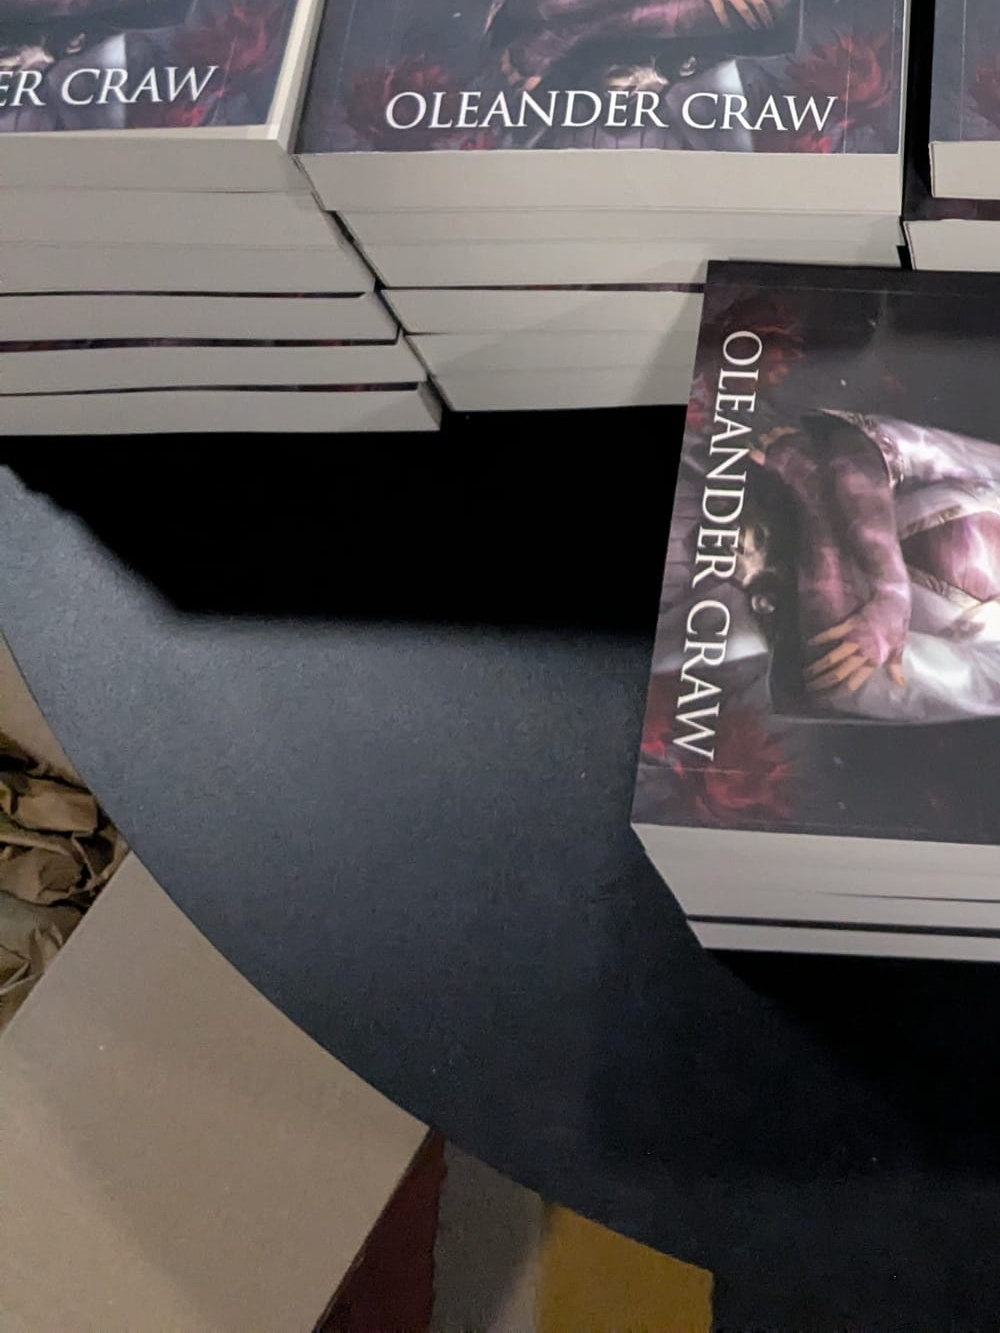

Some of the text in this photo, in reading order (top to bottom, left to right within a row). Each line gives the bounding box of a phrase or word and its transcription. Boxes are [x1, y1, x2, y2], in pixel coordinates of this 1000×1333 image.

[61, 65, 219, 106] CRAW
[385, 87, 839, 134] OLEANDER CRAW
[672, 330, 763, 761] OLEANDER CRAW
